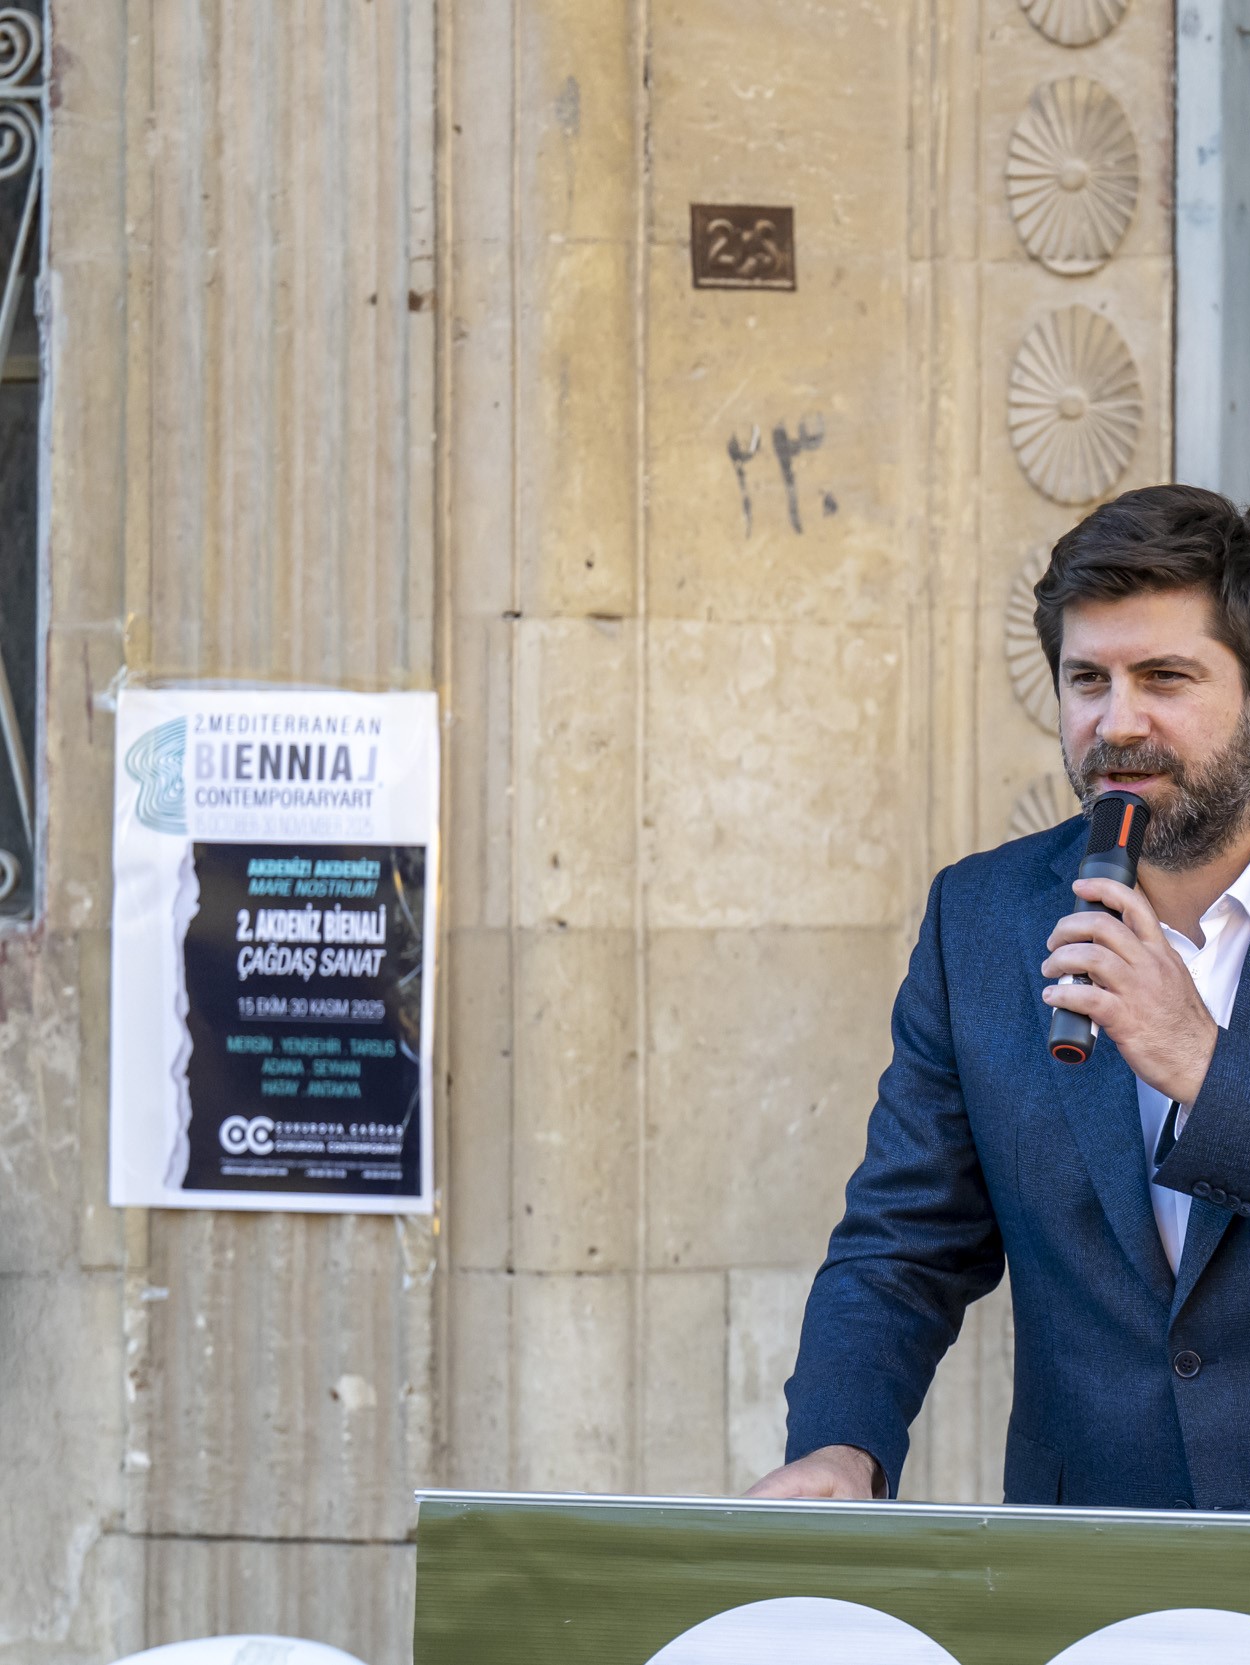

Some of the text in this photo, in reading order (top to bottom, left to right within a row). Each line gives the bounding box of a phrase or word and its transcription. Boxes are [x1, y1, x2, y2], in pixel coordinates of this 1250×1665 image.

[237, 902, 387, 944] 2. AKDENİZ BİENALİ
[237, 942, 387, 982] ÇAĞDAŞ SANAT
